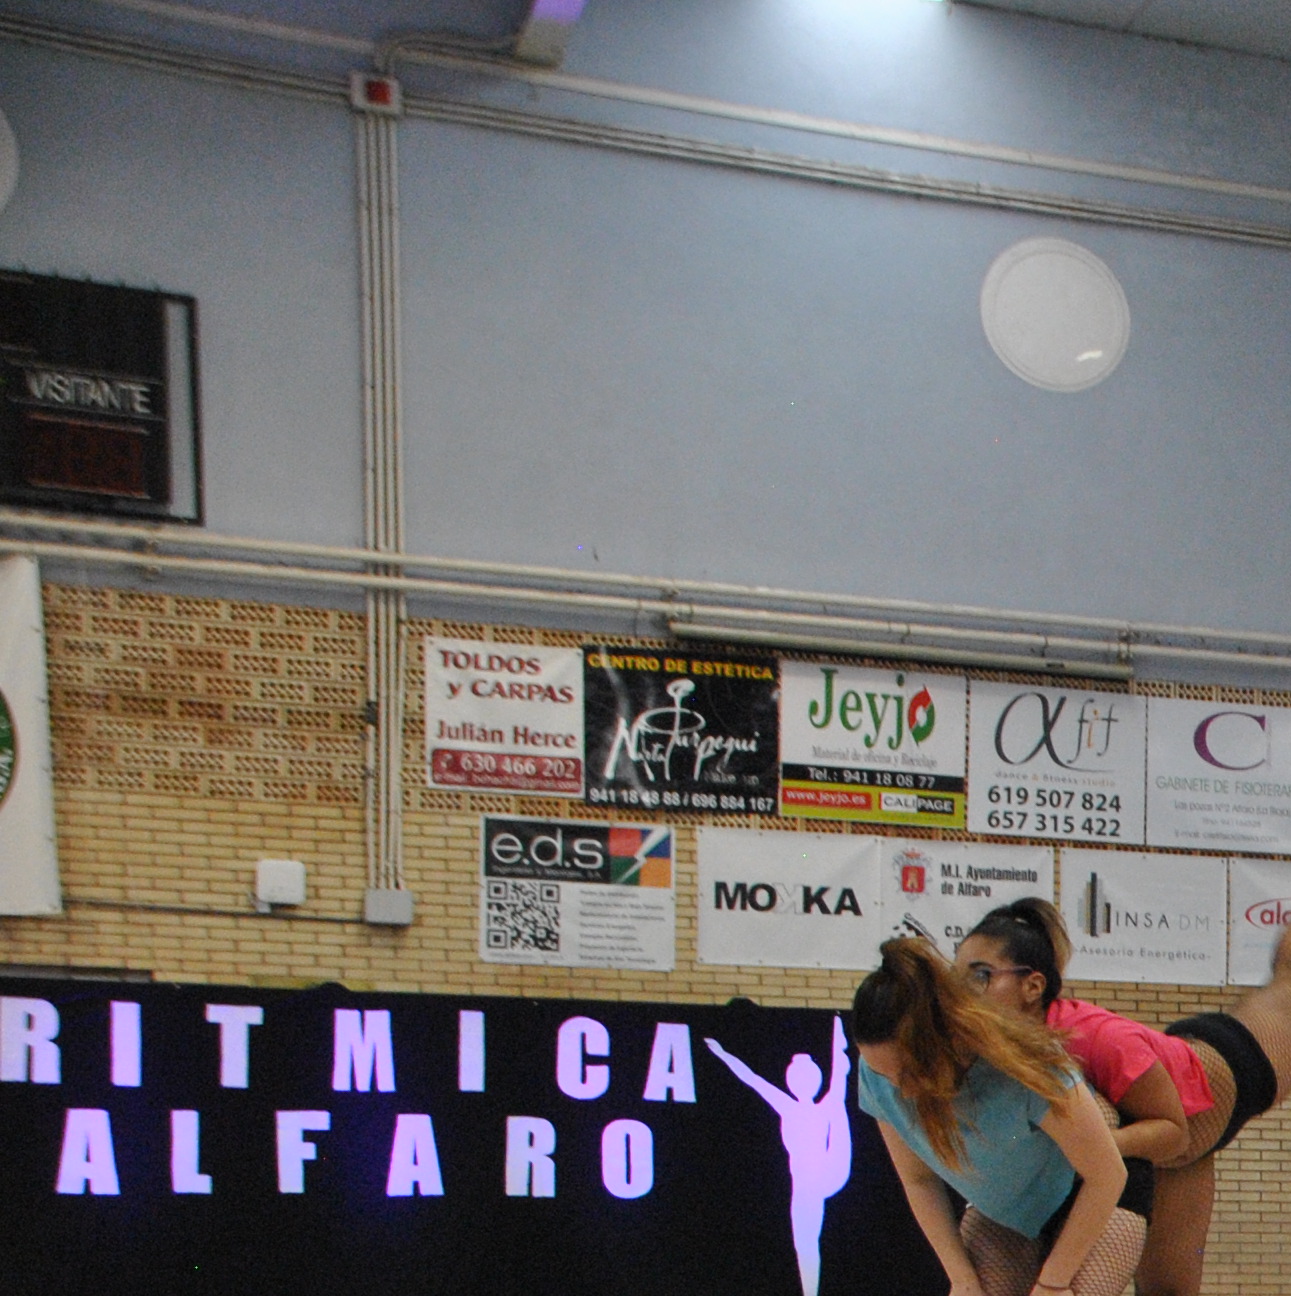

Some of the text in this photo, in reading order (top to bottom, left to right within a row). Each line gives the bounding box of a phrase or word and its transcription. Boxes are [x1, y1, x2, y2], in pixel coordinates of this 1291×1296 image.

[26, 369, 151, 413] VISITANTE
[438, 650, 542, 675] TOLDOS
[587, 653, 660, 672] CENTRO
[663, 657, 688, 674] DE
[446, 679, 575, 704] y CARPAS
[512, 725, 577, 749] Herce
[1193, 711, 1267, 771] C
[460, 752, 576, 779] 630 466 202
[842, 769, 869, 785] 941
[875, 772, 892, 787] 18
[896, 774, 914, 788] 08
[918, 775, 936, 789] 77
[1155, 775, 1210, 793] GABINETE
[1213, 780, 1230, 795] DE
[589, 787, 616, 803] 941
[621, 788, 639, 804] 18
[750, 797, 775, 812] 167
[883, 795, 953, 813] CALIPAGE
[987, 785, 1122, 813] 619 507 824
[987, 810, 1121, 837] 657 315 422
[491, 827, 604, 870] e.d.s
[966, 864, 1038, 883] Ayuntamiento
[941, 881, 991, 898] de Alfaro
[1179, 914, 1210, 931] DM
[55, 1108, 655, 1200] ALFARO
